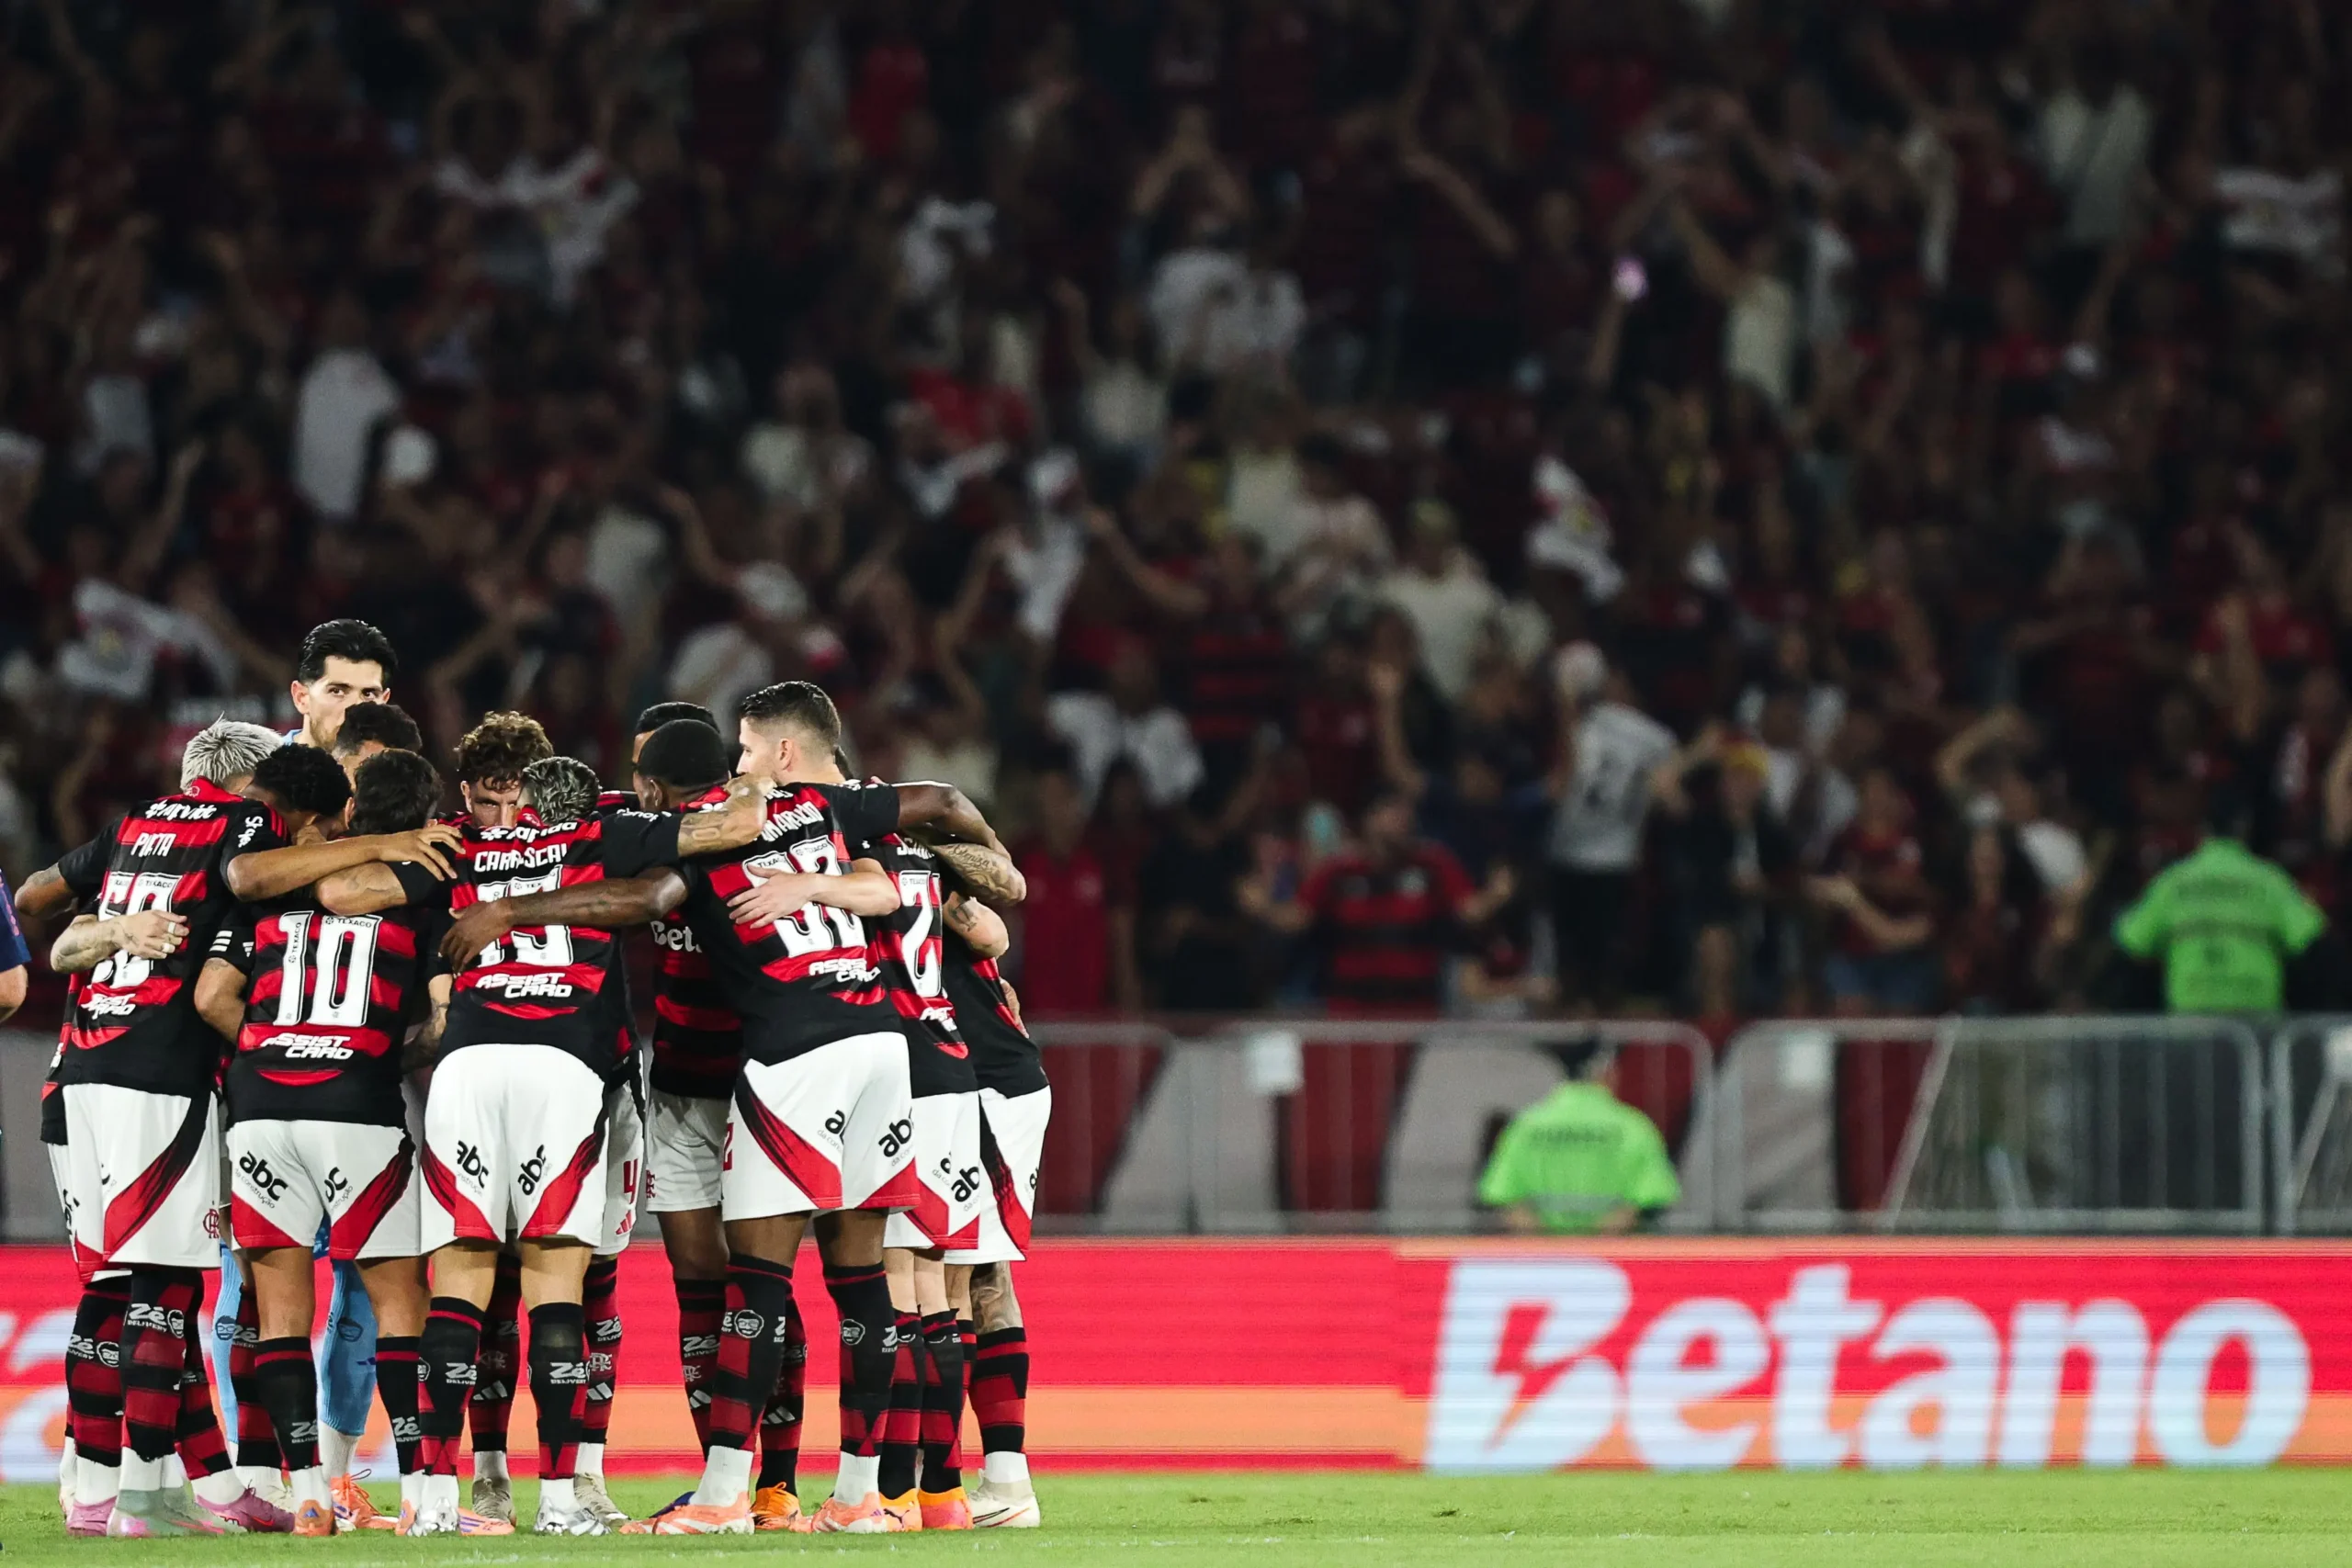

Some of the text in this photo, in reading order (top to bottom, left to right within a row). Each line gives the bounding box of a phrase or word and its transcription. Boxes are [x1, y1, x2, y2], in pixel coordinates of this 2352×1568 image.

[336, 919, 373, 929] TEXACO
[291, 921, 302, 955] TEXACO
[650, 920, 703, 953] Bet
[273, 910, 383, 1027] 10
[475, 973, 566, 989] ASSIST
[504, 984, 572, 998] CARD
[260, 1032, 351, 1047] ASSIST
[285, 1046, 354, 1060] CARD
[877, 1106, 914, 1157] ab
[239, 1150, 288, 1201] abc
[324, 1167, 348, 1203] bc
[951, 1166, 980, 1202] ab
[241, 1174, 276, 1209] construção
[129, 1303, 167, 1326] Zé
[722, 1312, 733, 1327] é
[127, 1319, 167, 1333] DELIVERY
[596, 1315, 622, 1337] Zé
[775, 1316, 786, 1336] Z
[882, 1325, 898, 1347] Z
[67, 1348, 95, 1360] LIVERY
[68, 1334, 96, 1355] Zé
[683, 1335, 720, 1352] Zé
[549, 1361, 586, 1379] Zé
[1424, 1258, 2312, 1473] Betano
[392, 1416, 421, 1437] Zé
